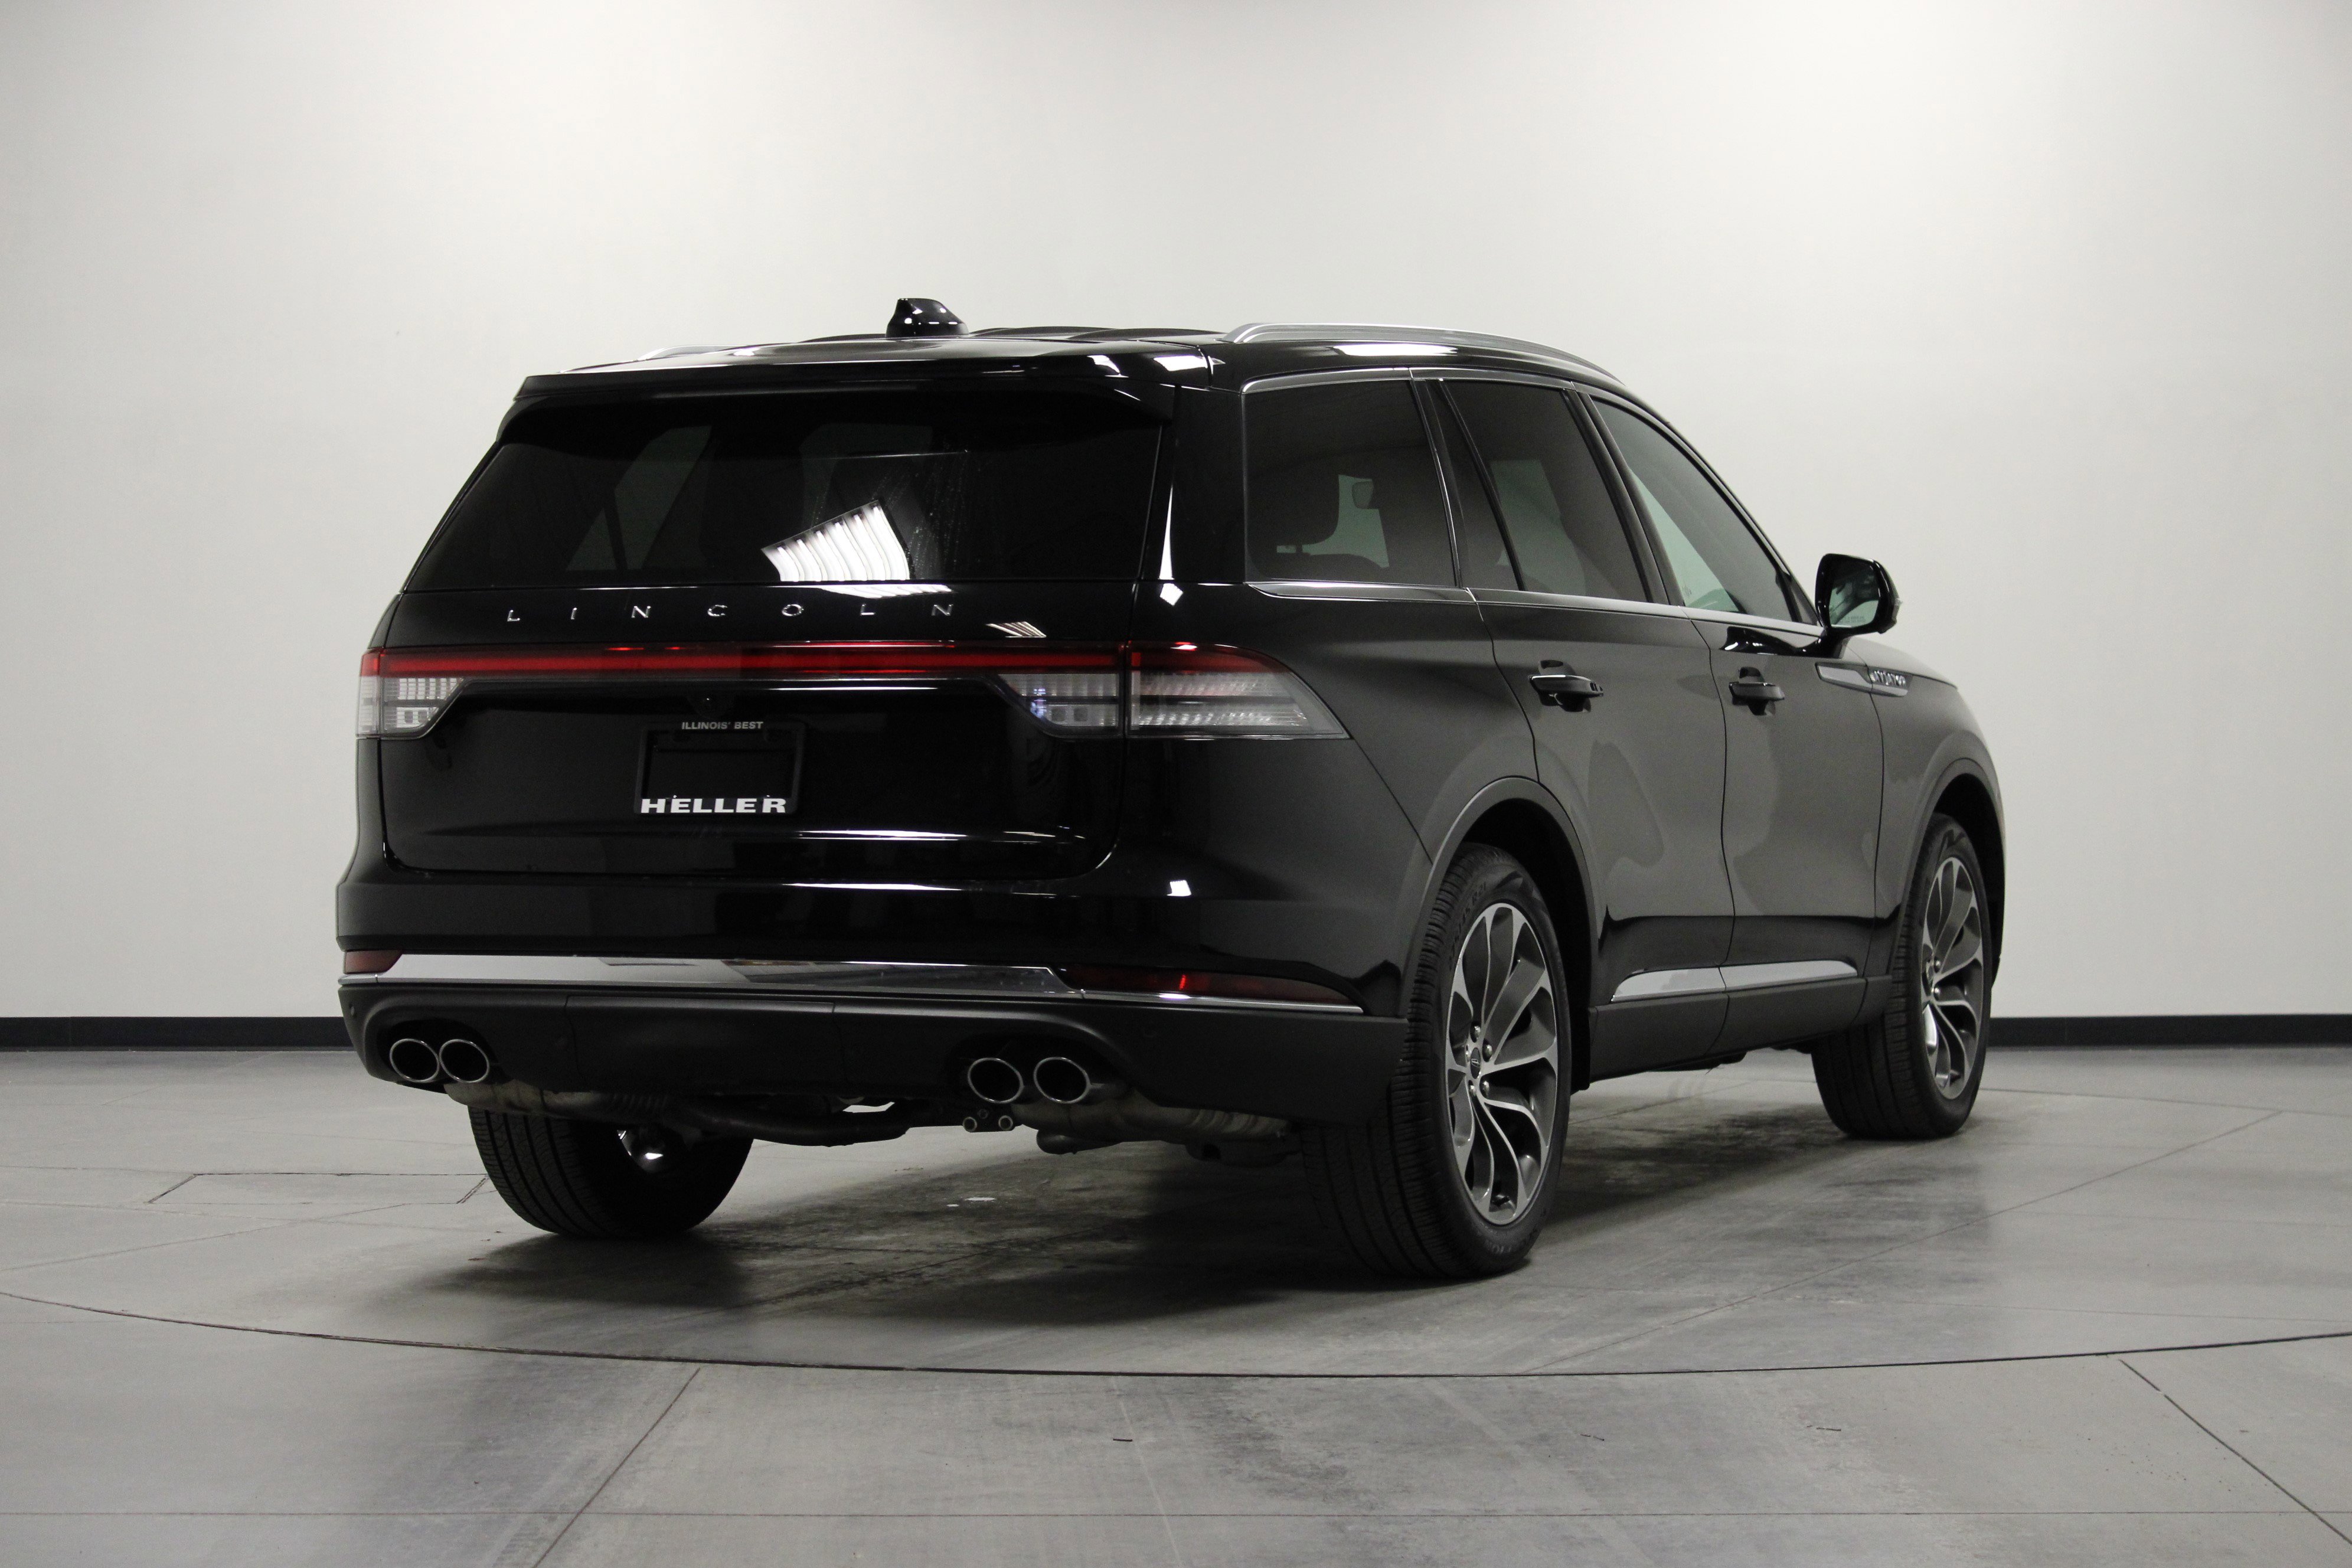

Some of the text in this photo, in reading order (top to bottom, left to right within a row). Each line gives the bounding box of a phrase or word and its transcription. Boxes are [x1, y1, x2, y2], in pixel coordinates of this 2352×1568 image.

[507, 603, 955, 622] LINCOLN
[681, 721, 764, 730] ILLINOIS' BEST
[641, 798, 787, 814] HELLER
